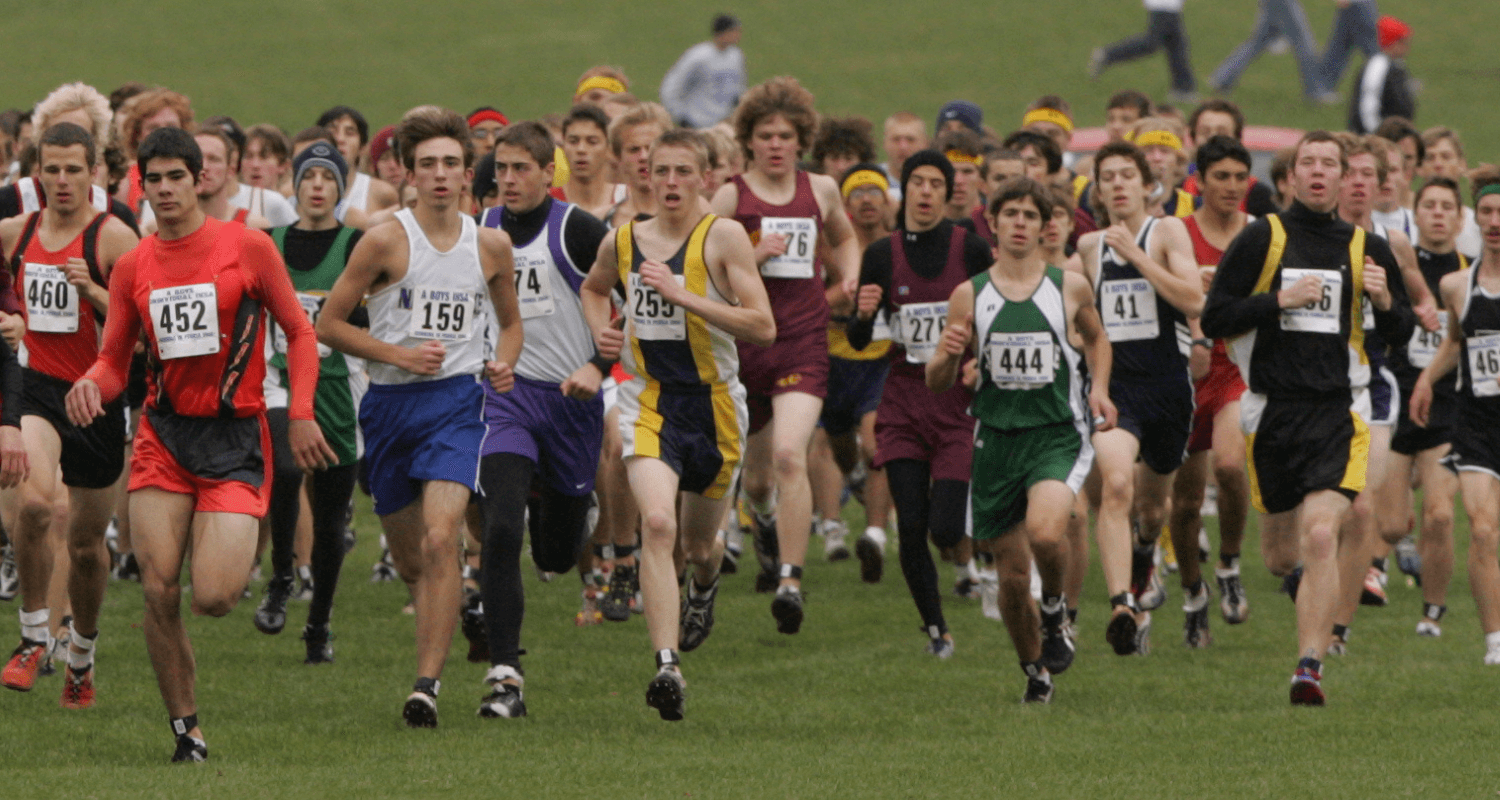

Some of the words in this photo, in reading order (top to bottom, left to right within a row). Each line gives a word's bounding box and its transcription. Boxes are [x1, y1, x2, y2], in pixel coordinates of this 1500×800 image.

[28, 279, 69, 310] 460
[430, 290, 450, 301] BOYS
[634, 288, 675, 318] 255
[1114, 293, 1140, 319] 41
[160, 299, 207, 334] 452
[421, 302, 465, 332] 159
[1000, 347, 1044, 375] 444
[1476, 348, 1500, 376] 46
